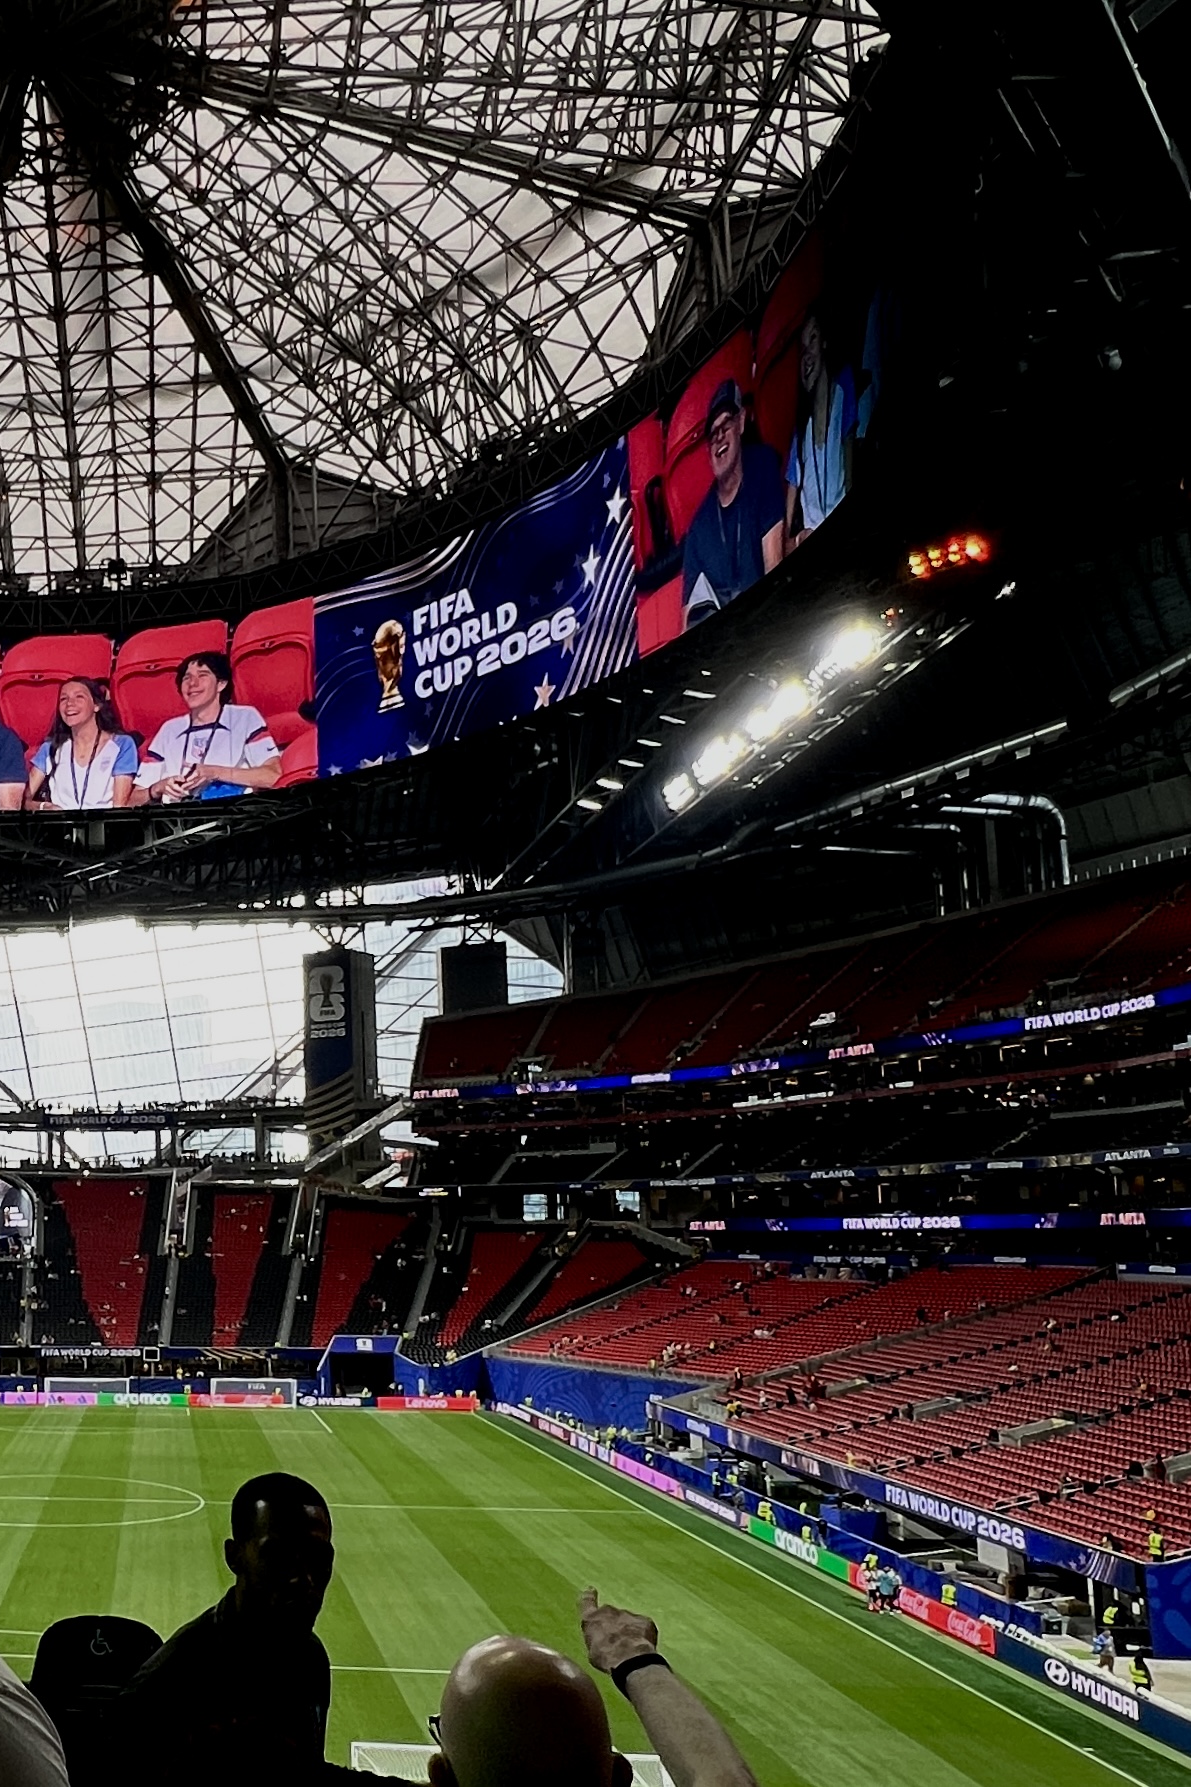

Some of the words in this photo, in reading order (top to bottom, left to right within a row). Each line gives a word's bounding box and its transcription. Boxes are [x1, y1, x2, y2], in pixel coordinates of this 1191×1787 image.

[413, 588, 475, 636] FIFA
[412, 602, 518, 667] WORLD
[414, 655, 473, 698] CUP
[476, 607, 576, 677] 2026
[1024, 1016, 1053, 1030] FIFA
[1052, 1007, 1101, 1027] WORLD
[1101, 1003, 1121, 1019] CUP
[828, 1043, 875, 1060] ATLANTA
[49, 1117, 71, 1125] FIFA
[72, 1116, 108, 1125] WORLD
[108, 1116, 129, 1124] CUP
[1104, 1149, 1152, 1162] ATLANTA
[810, 1170, 855, 1179] ATLANTA
[865, 1217, 900, 1230] WORLD
[901, 1216, 922, 1229] CUP
[41, 1348, 60, 1357] FIFA
[60, 1348, 92, 1357] WORLD
[92, 1348, 110, 1357] CUP
[405, 1397, 449, 1408] Lenovo
[885, 1483, 907, 1508] FIFA
[909, 1491, 950, 1522] WORLD
[951, 1506, 976, 1531] CUP
[977, 1515, 1026, 1550] 2026
[1071, 1671, 1140, 1721] HYUNDAI
